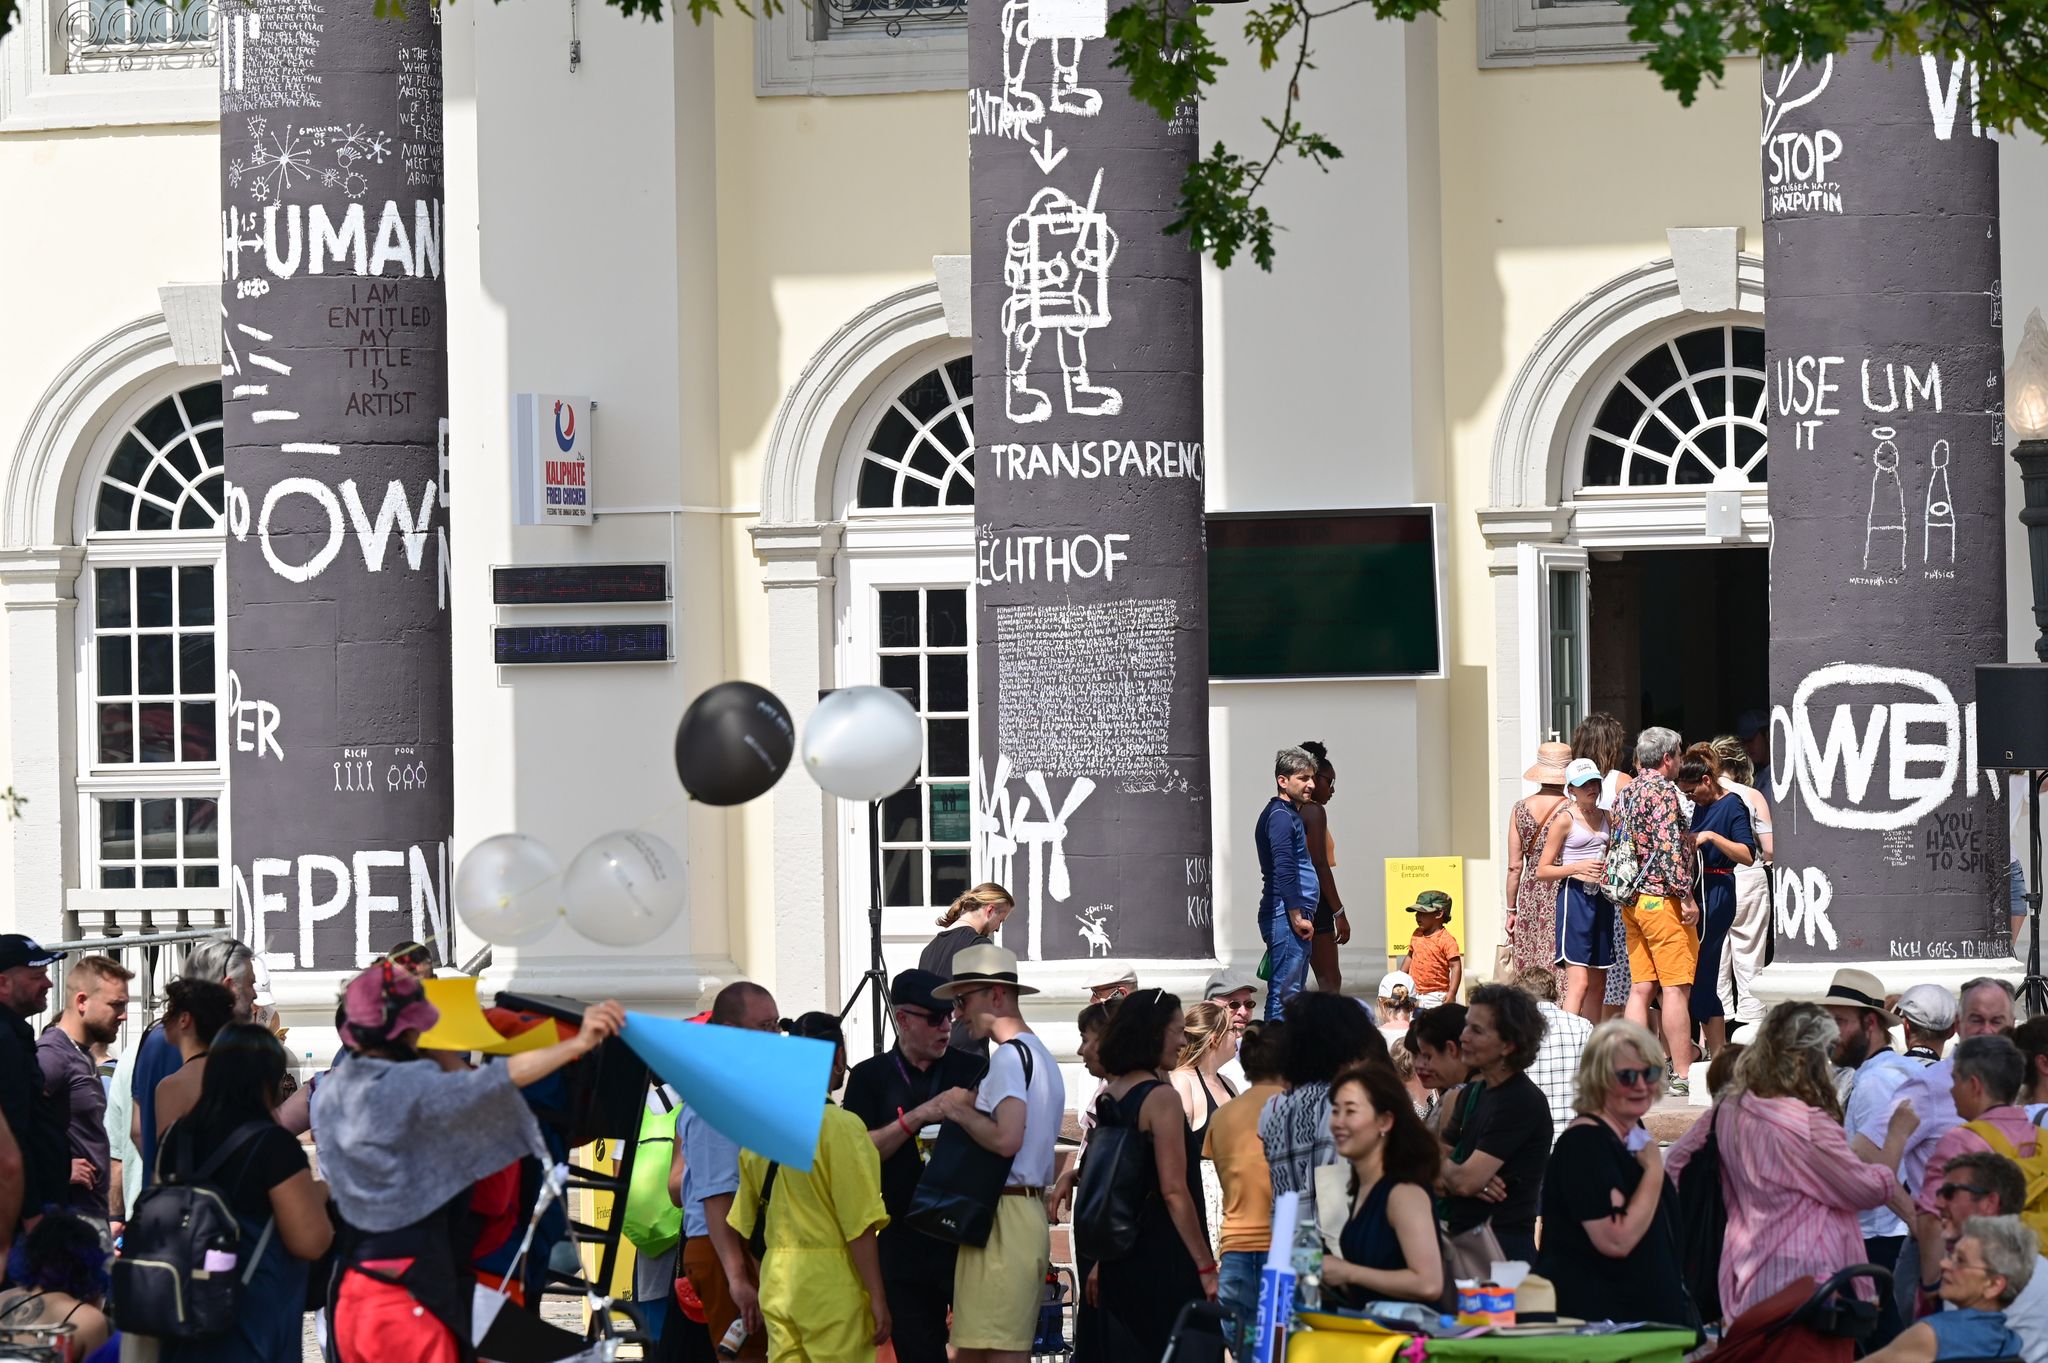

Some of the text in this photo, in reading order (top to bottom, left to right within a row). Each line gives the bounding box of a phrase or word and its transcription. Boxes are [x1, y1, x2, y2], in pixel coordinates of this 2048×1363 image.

[412, 47, 428, 61] THE
[403, 61, 430, 75] WHEN
[399, 74, 412, 88] MY
[399, 85, 430, 100] ARTISTS
[410, 101, 420, 113] OF
[400, 113, 416, 127] WE
[313, 139, 326, 148] US
[401, 143, 427, 160] NOW
[406, 157, 430, 173] MEET
[1769, 129, 1843, 185] STOP
[407, 171, 436, 188] ABOUT
[1773, 191, 1843, 215] RAZPUTIN
[236, 278, 270, 299] 2020
[352, 284, 399, 304] I AM
[360, 328, 395, 347] MY
[343, 348, 412, 368] TITLE
[372, 368, 388, 390] IS
[1778, 355, 1944, 416] USE UM
[345, 391, 417, 416] ARTIST
[1796, 420, 1824, 450] IT
[991, 440, 1204, 482] TRANSPARENC
[545, 461, 586, 486] KALIPHATE
[546, 487, 587, 506] FRIED CHICKEN
[344, 747, 415, 758] RICH POOR
[1934, 813, 1972, 836] YOU
[1926, 829, 1982, 853] HAVE
[1401, 864, 1425, 872] Eingang
[1926, 852, 1953, 872] TO
[232, 840, 453, 970] DEPEN
[1927, 941, 1957, 958] GOES
[1961, 940, 1974, 958] TO
